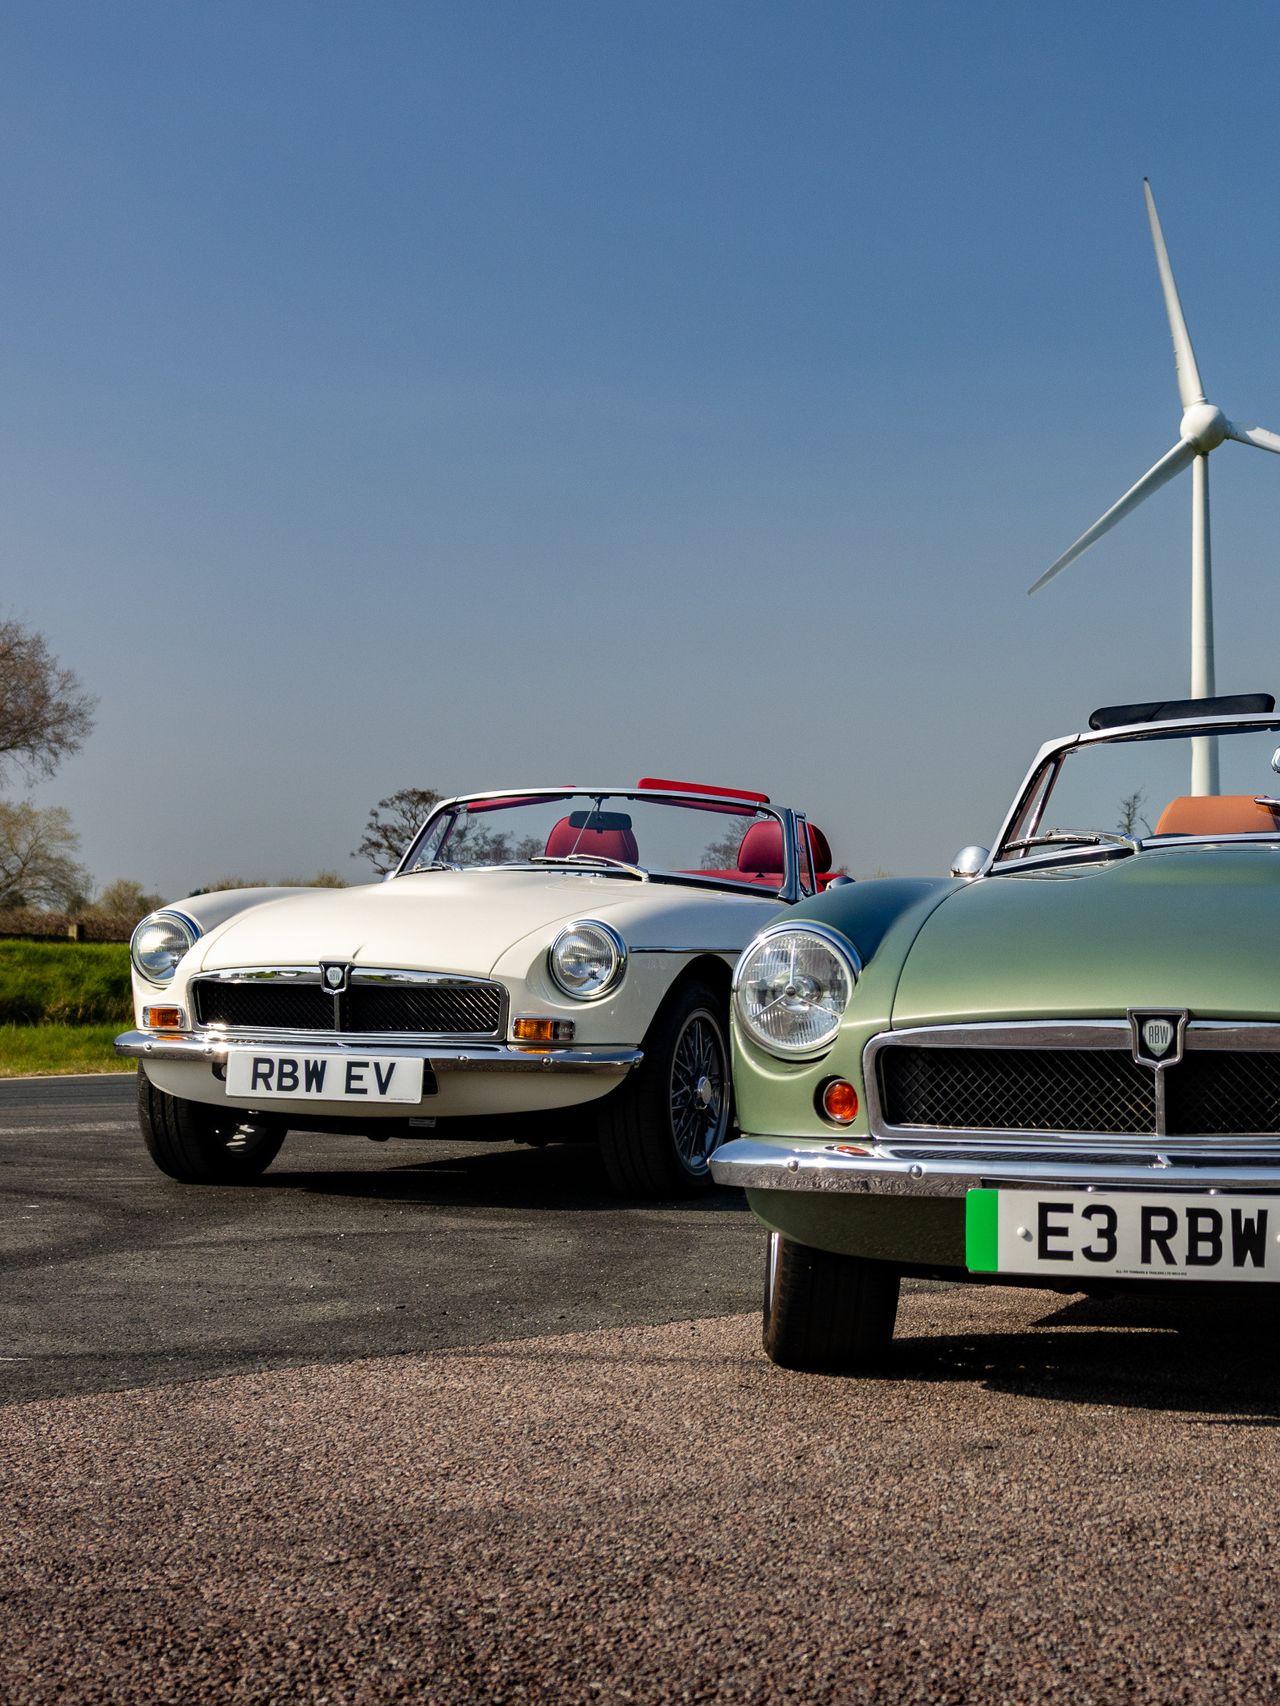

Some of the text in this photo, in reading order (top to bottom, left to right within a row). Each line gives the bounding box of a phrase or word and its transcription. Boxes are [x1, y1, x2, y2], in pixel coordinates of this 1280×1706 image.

[1148, 1024, 1170, 1045] RBW
[251, 1057, 396, 1095] RBW EV
[1037, 1201, 1269, 1268] E3 RBW
